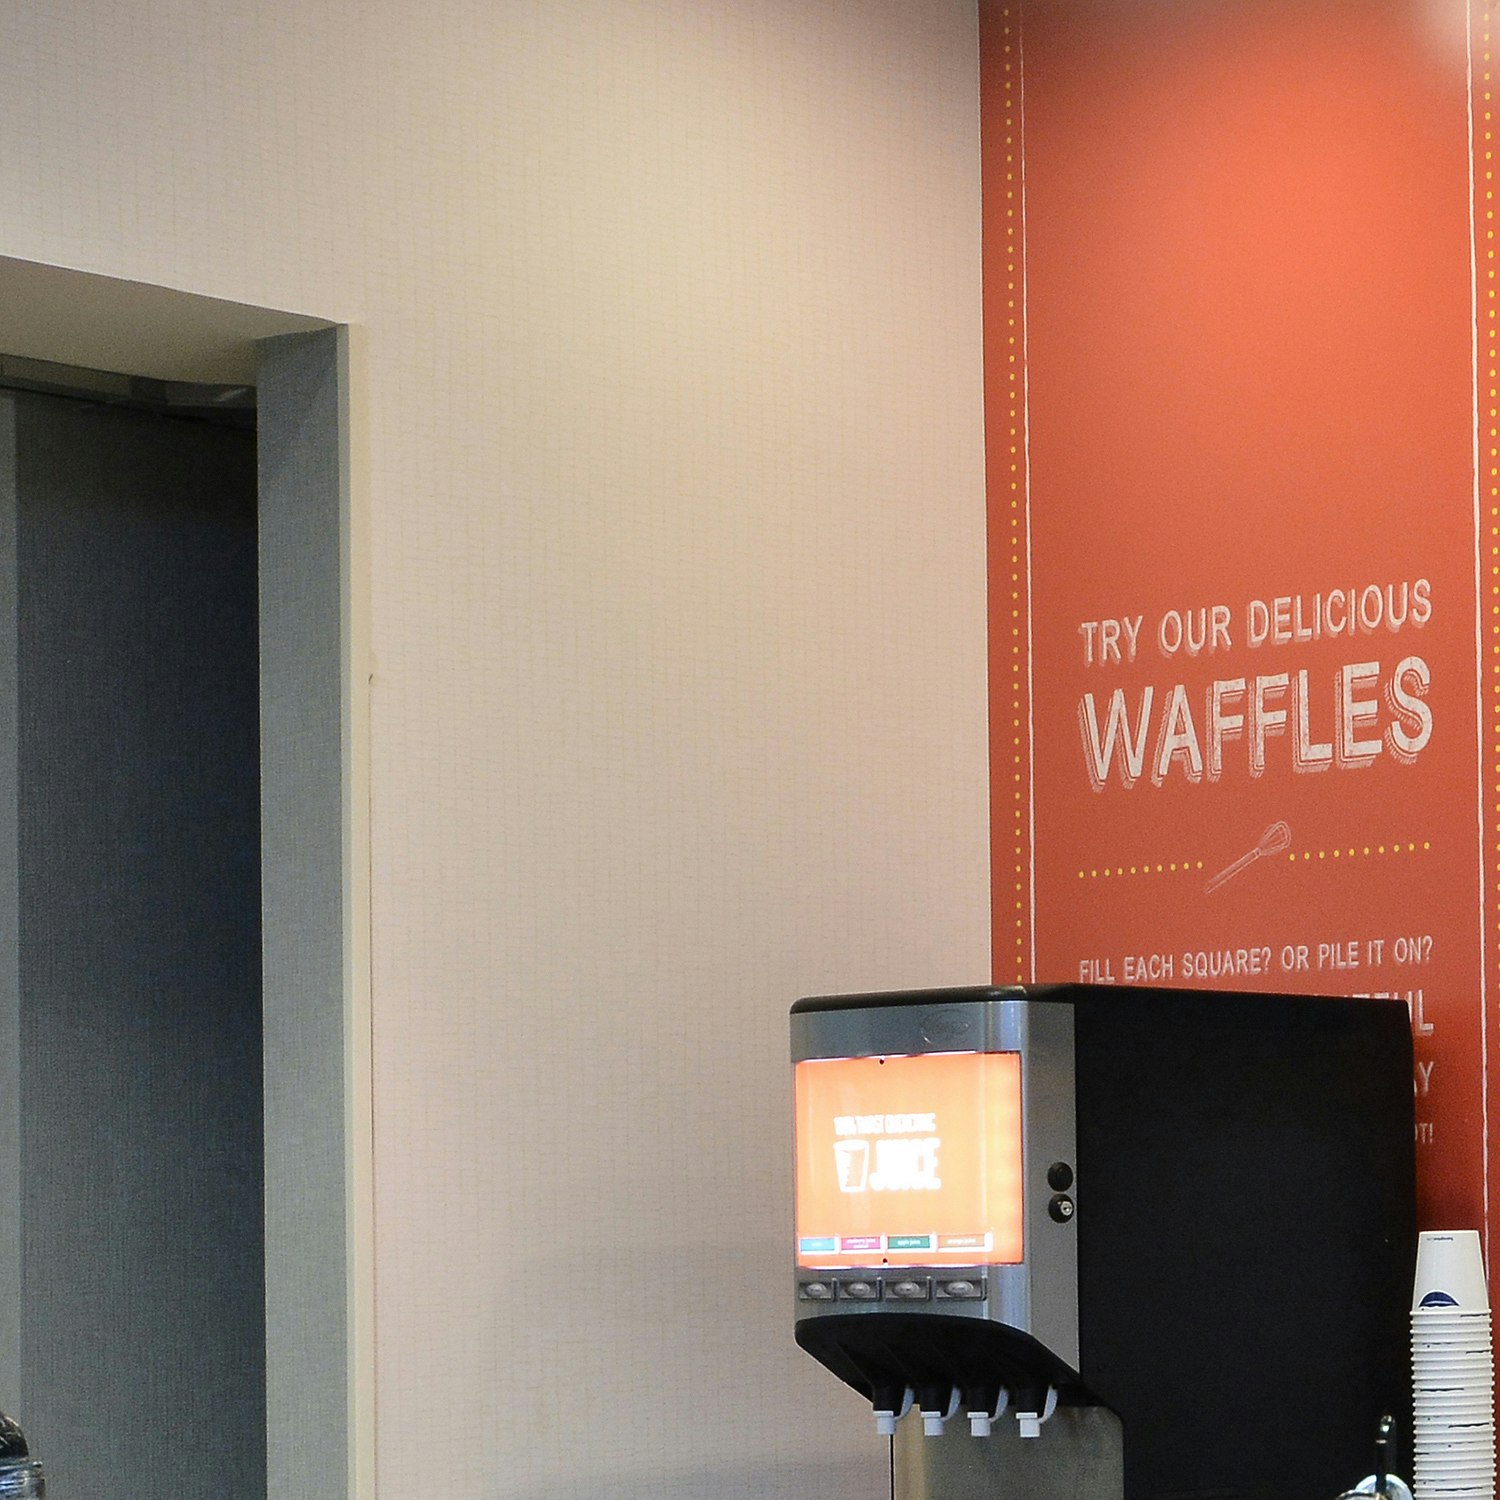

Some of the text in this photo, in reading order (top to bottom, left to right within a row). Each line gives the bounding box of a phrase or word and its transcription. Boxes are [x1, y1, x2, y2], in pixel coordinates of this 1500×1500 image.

[1078, 578, 1432, 667] TRY OUR DELICIOUS
[1078, 655, 1433, 793] WAFFLES
[1078, 936, 1433, 983] FILL EACH SQUARE? OR PILE IT ON?
